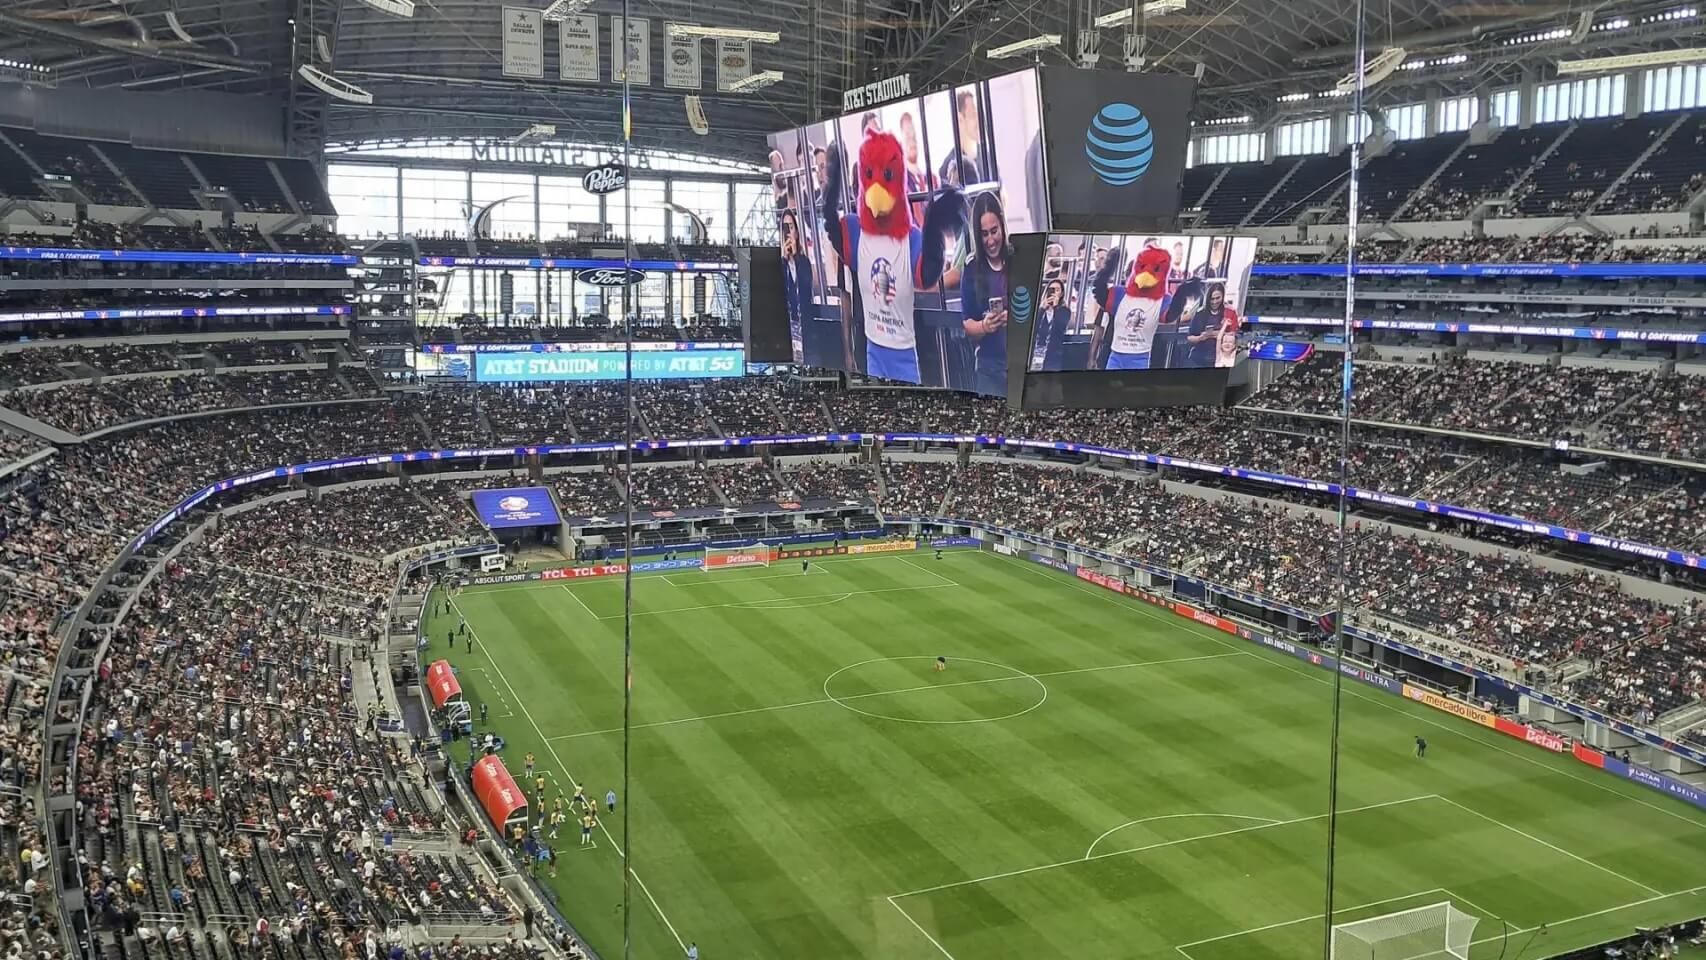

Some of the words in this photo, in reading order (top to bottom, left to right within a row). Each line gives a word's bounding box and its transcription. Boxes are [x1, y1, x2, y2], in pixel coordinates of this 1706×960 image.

[844, 86, 865, 112] AT&T
[866, 73, 912, 105] STADIUM
[604, 168, 620, 178] Dr
[584, 170, 625, 191] Peppe
[484, 360, 525, 374] AT&T
[528, 359, 598, 373] STADIUM
[604, 359, 650, 370] POWRED
[654, 359, 665, 369] BY
[668, 357, 707, 372] AT&T
[709, 356, 735, 371] 5G
[542, 570, 567, 579] TCL
[574, 568, 596, 576] TCL
[602, 565, 626, 574] TCL
[474, 576, 503, 584] ABSOLUT
[505, 574, 525, 582] SPORT
[1193, 610, 1217, 626] Betano
[1264, 636, 1295, 653] ARLINGTON
[1365, 672, 1389, 687] ULTRA
[1426, 695, 1465, 715] mercado
[1467, 709, 1487, 723] libre
[1636, 770, 1660, 783] LATAM
[1677, 787, 1698, 800] DELTA
